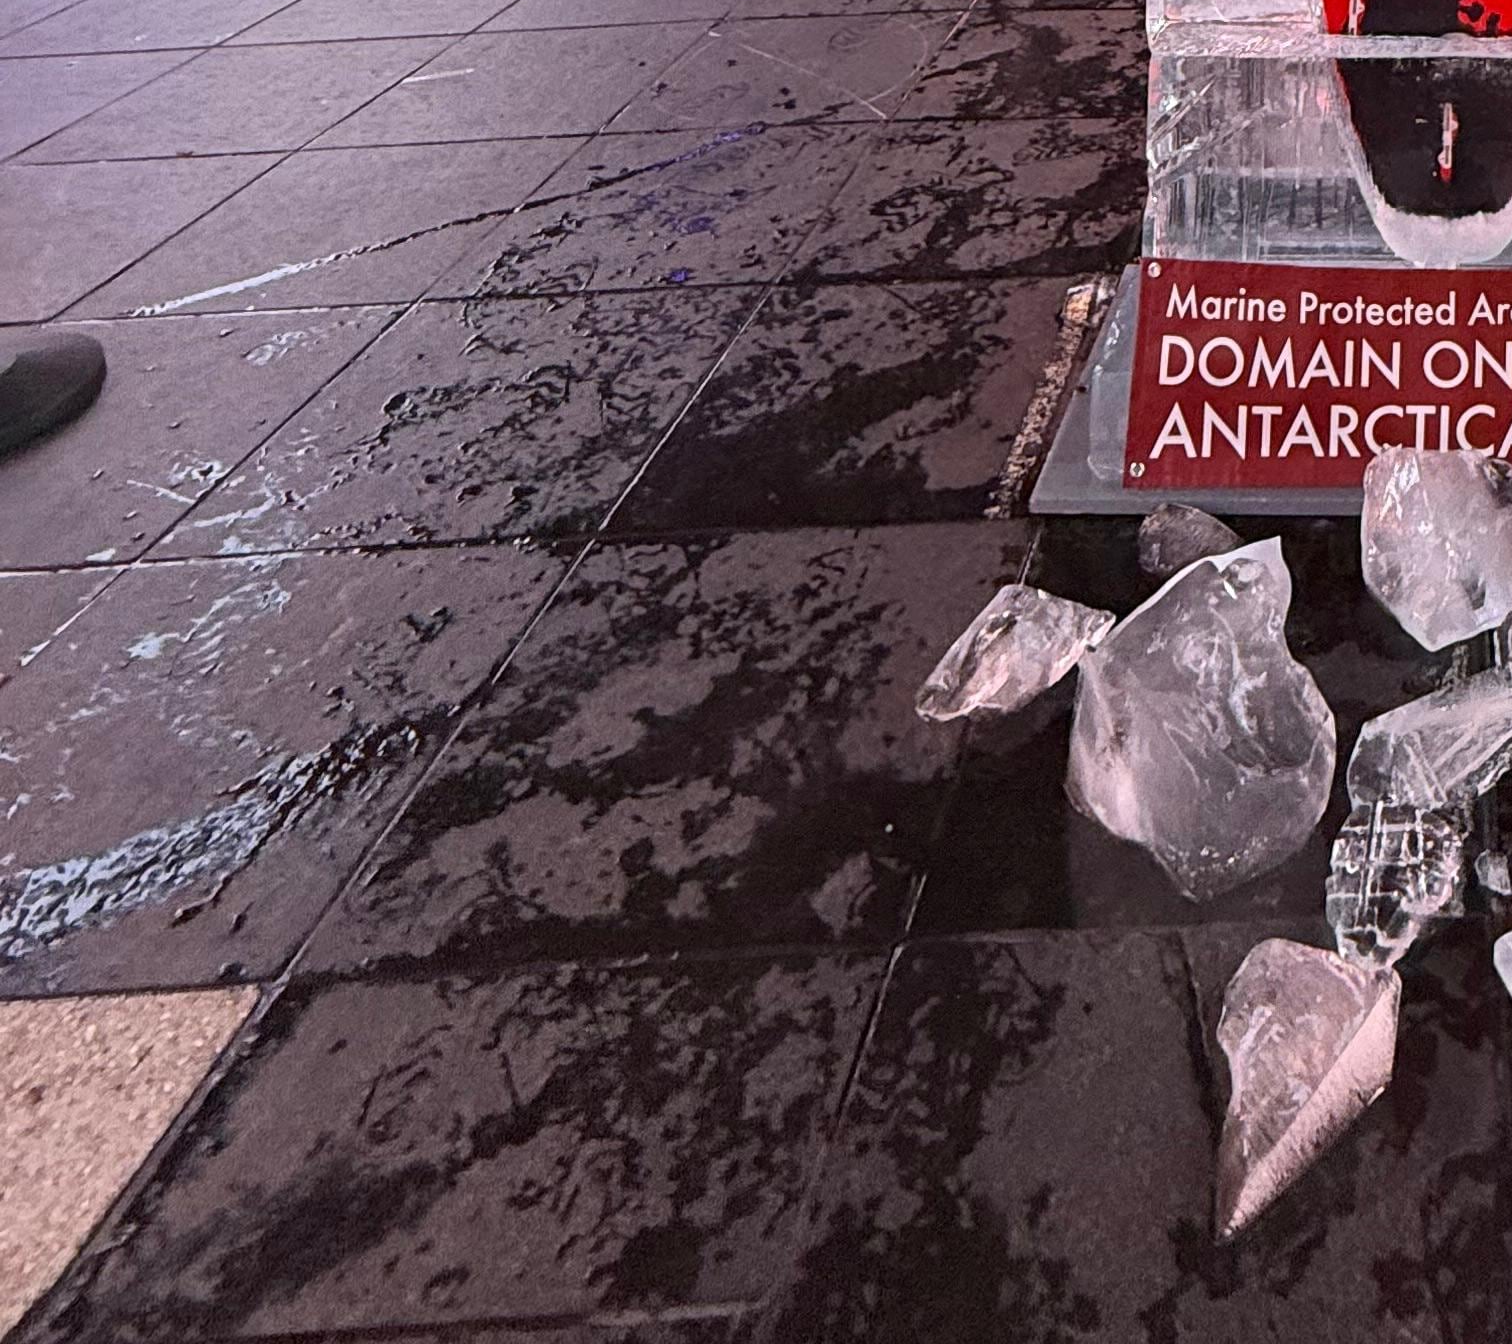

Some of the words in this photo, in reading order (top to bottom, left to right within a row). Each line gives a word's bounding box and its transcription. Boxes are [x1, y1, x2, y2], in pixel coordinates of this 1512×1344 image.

[1166, 283, 1287, 323] Marine
[1299, 290, 1456, 327] Protected
[1158, 335, 1401, 390] DOMAIN
